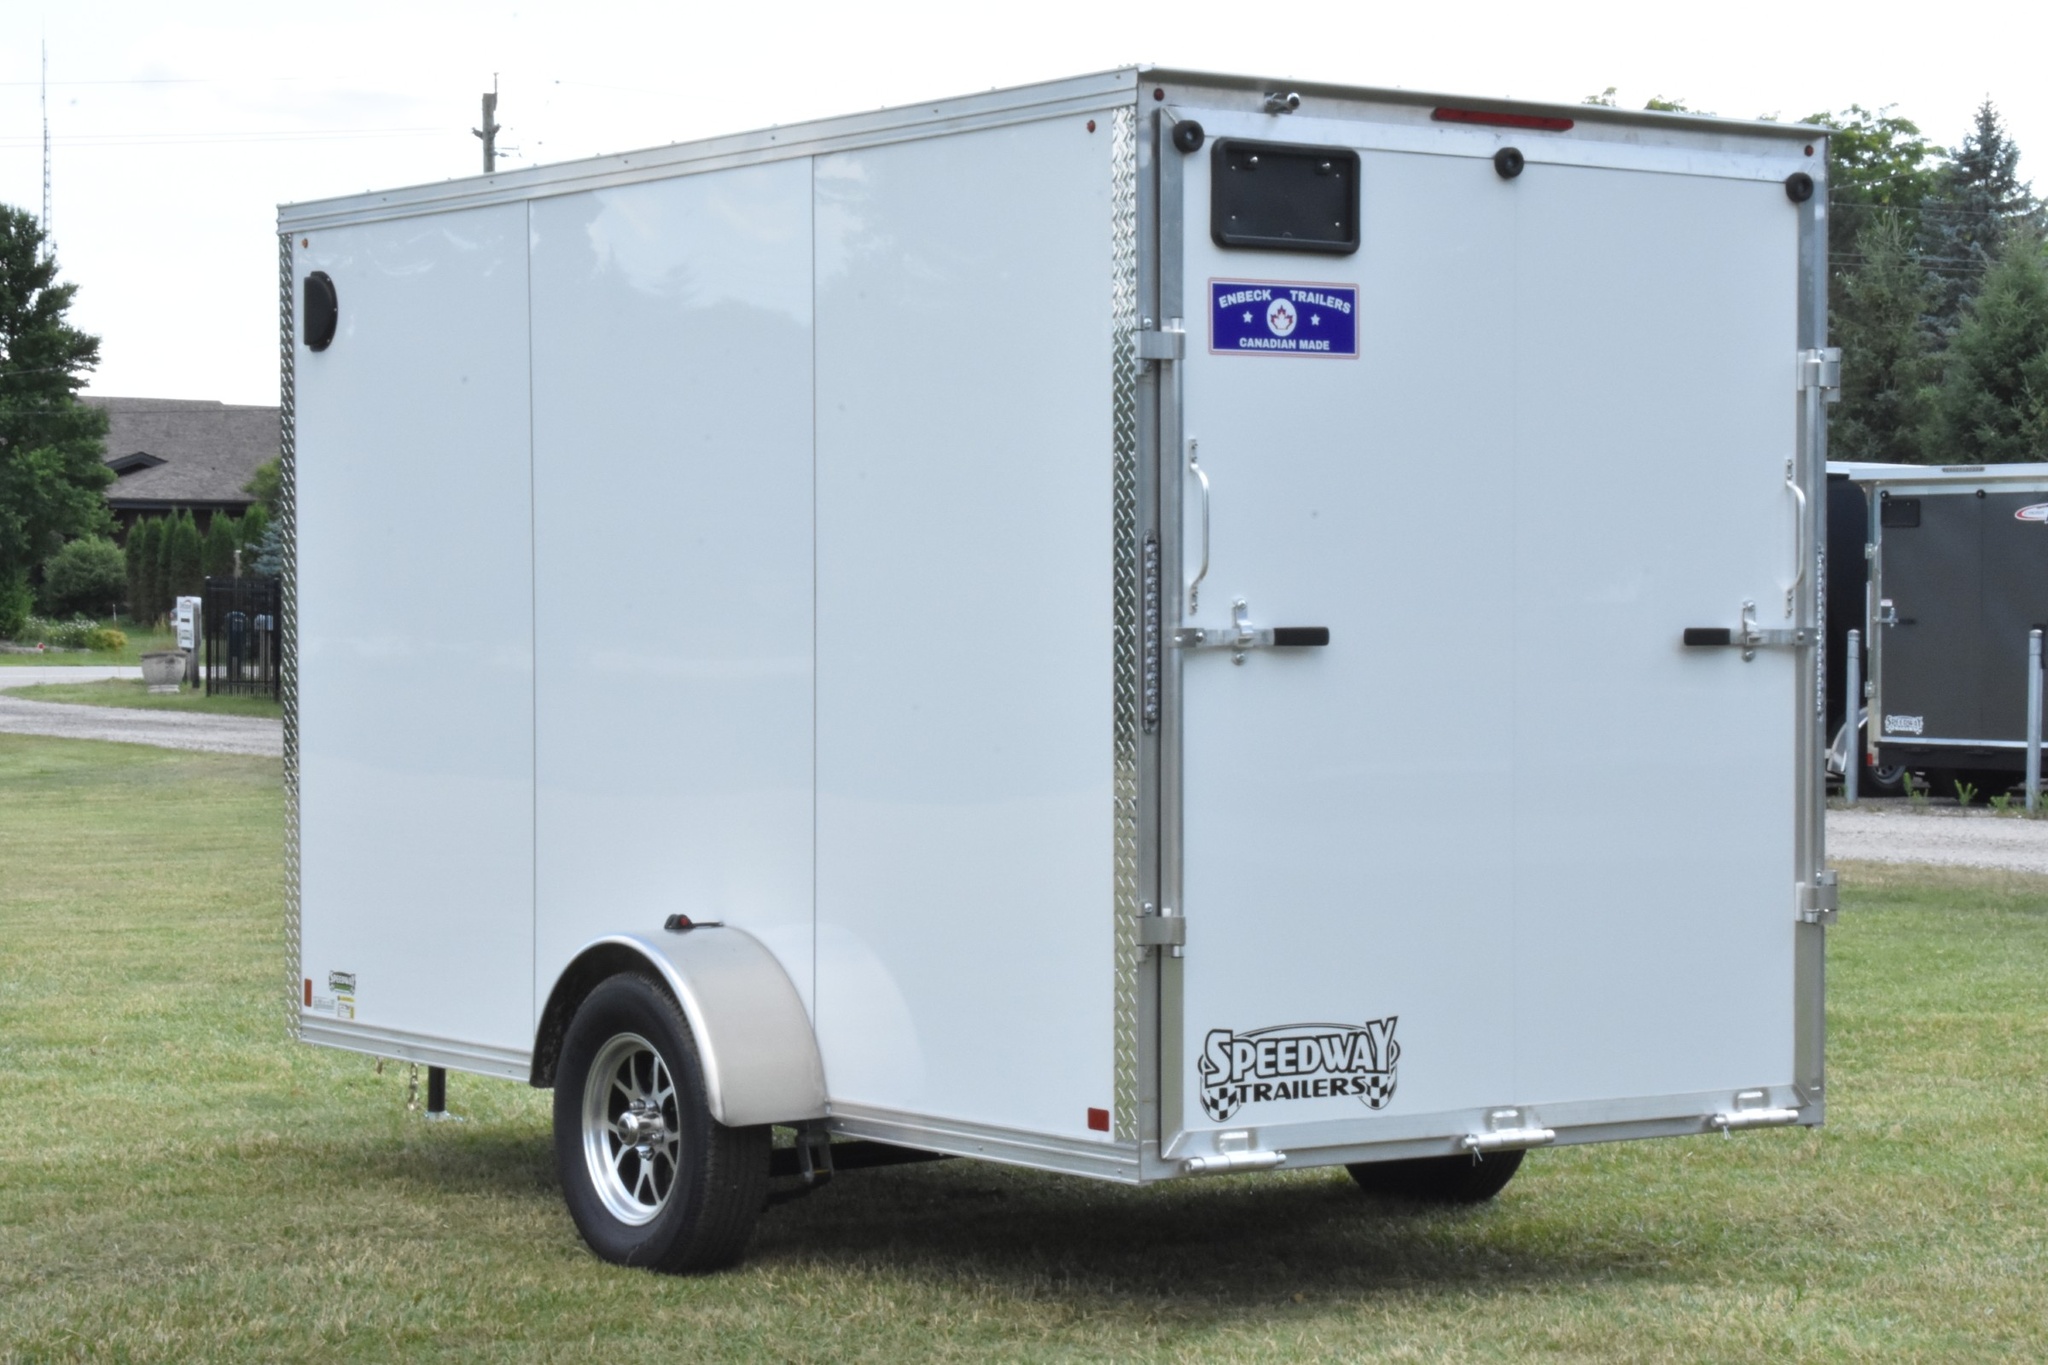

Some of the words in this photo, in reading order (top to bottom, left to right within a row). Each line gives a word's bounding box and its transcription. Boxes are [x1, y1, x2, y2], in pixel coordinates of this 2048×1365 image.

[1218, 289, 1272, 308] ENBECK
[1290, 289, 1351, 314] TRAILERS
[1239, 337, 1296, 350] CANADIAN
[1299, 340, 1330, 351] MADE
[1204, 1016, 1398, 1088] SPEEDWAY
[1236, 1076, 1366, 1103] TRAILERS
